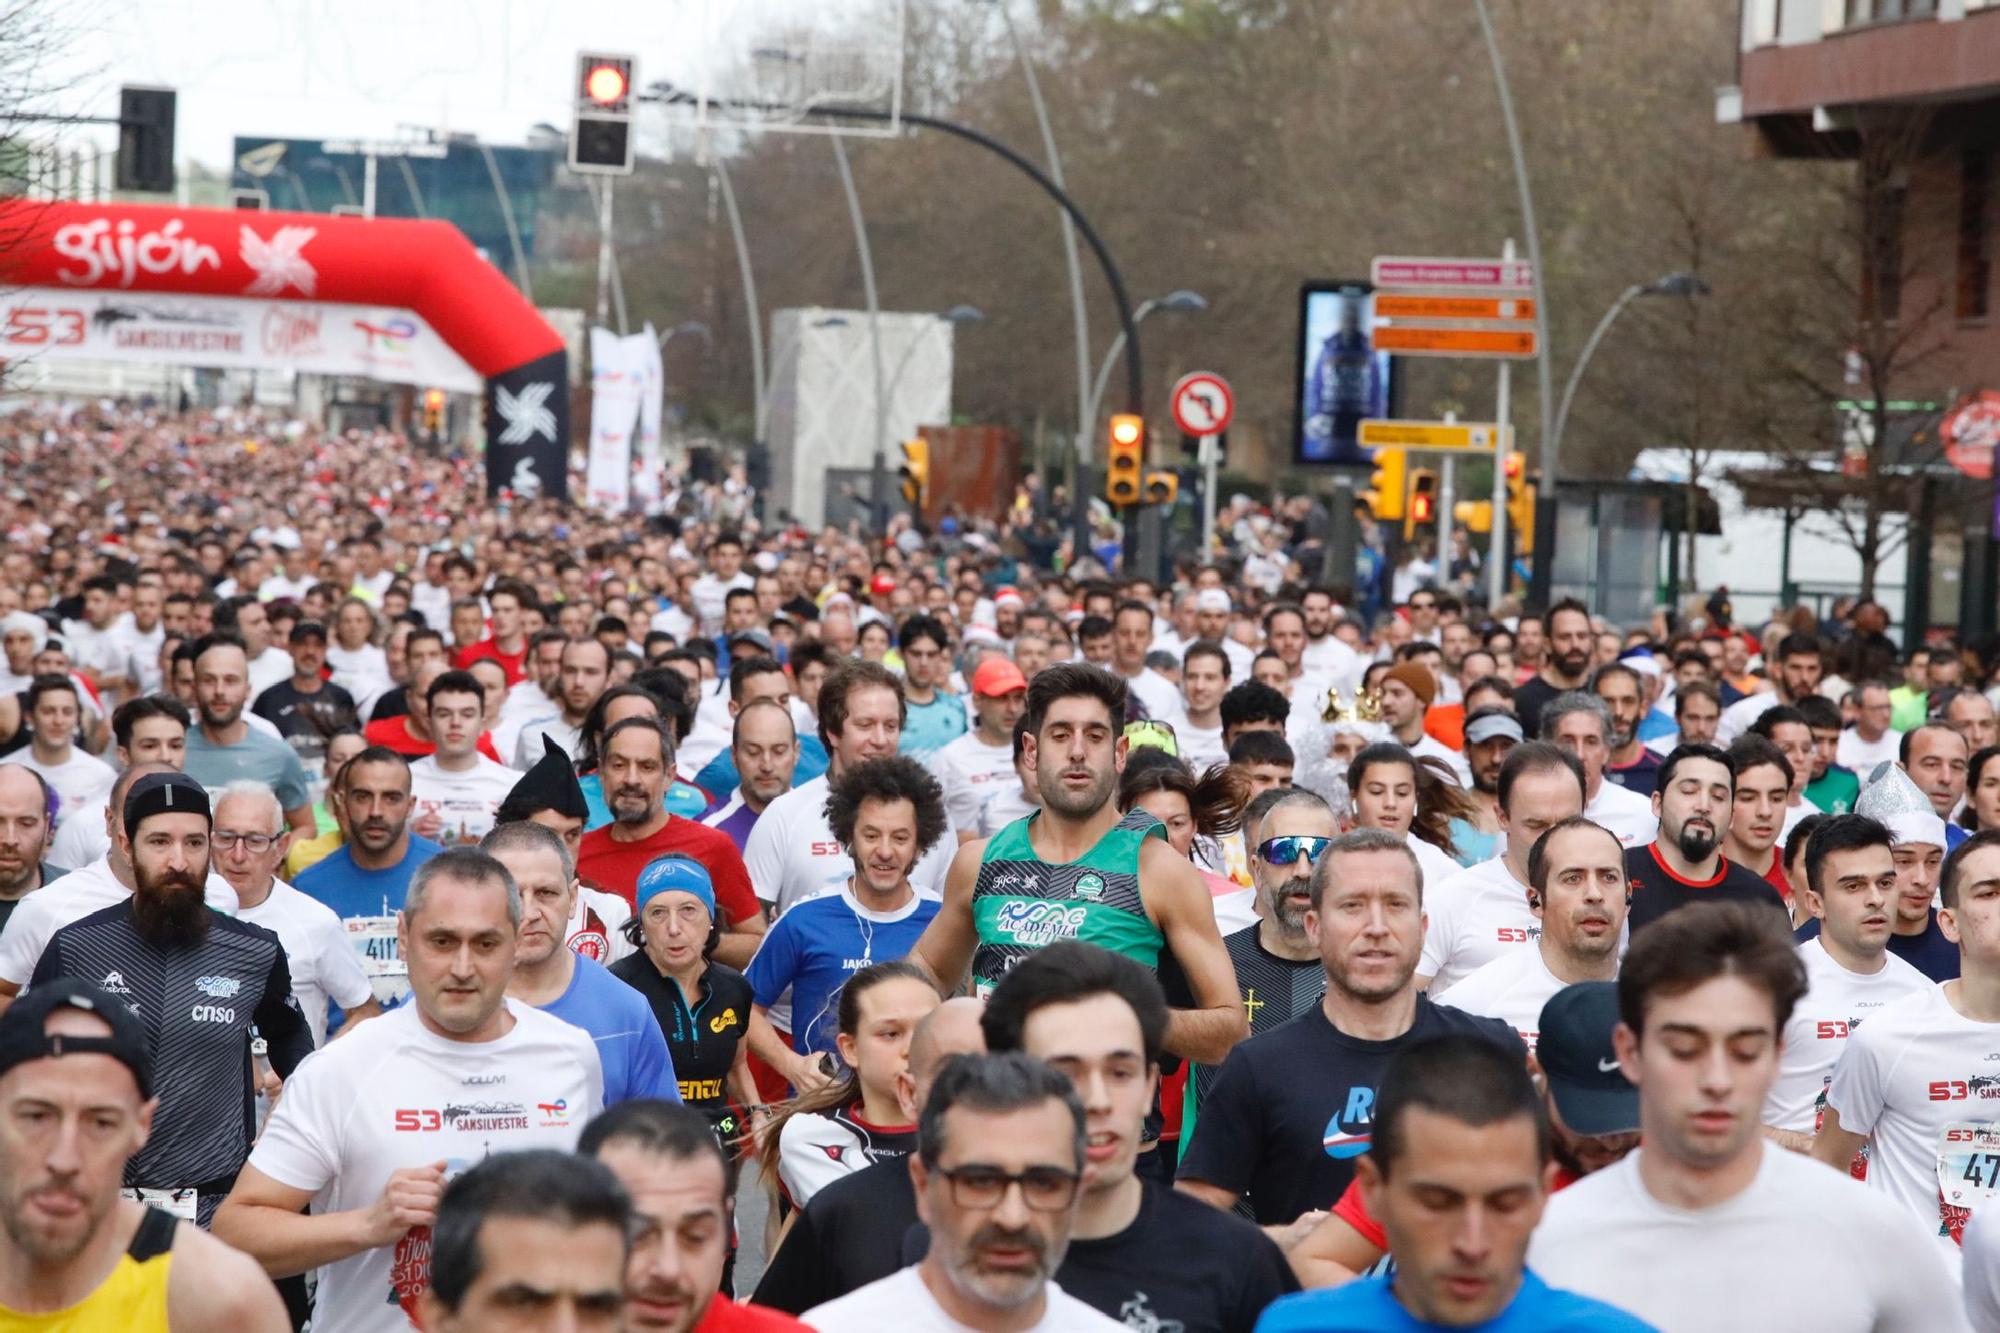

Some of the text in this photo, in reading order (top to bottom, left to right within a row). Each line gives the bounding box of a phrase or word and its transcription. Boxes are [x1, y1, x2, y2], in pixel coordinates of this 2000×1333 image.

[53, 218, 221, 288] gijón
[7, 308, 85, 345] 53
[812, 842, 840, 855] 53
[1000, 919, 1077, 937] ACADEMIA
[1497, 928, 1527, 942] 53
[1817, 1021, 1848, 1039] 53
[1929, 1081, 1967, 1101] 53
[1343, 1087, 1378, 1124] R
[395, 1109, 529, 1132] 53 SANSILVESTRE
[1946, 1130, 1973, 1142] 53
